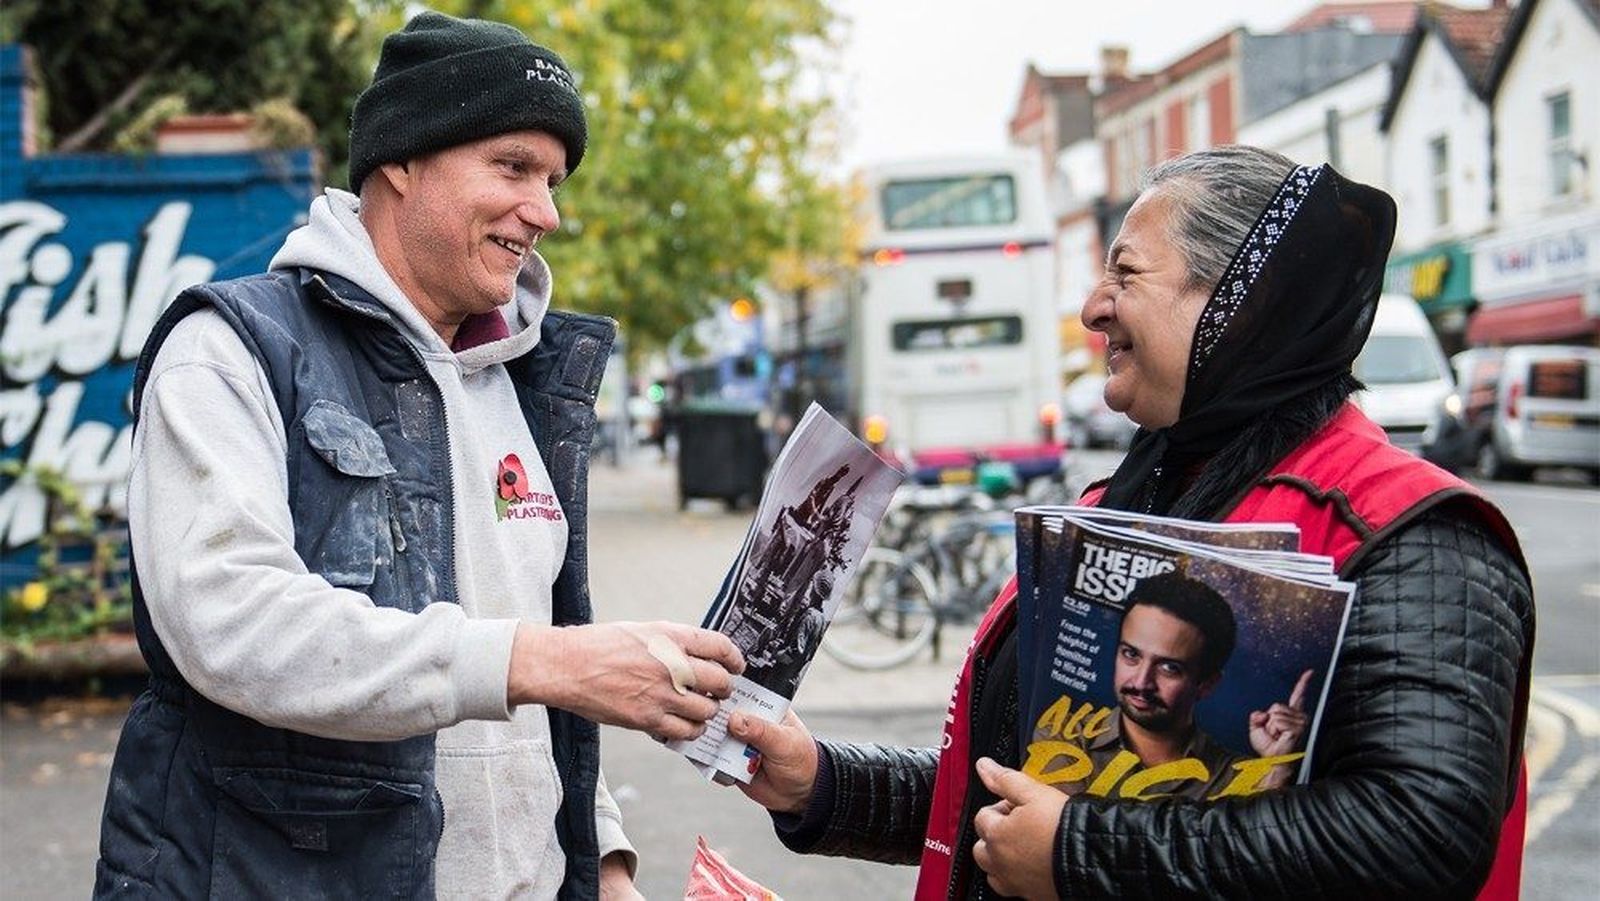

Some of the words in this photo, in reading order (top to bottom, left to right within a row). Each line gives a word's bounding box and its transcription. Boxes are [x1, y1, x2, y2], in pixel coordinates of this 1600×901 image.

[1083, 542, 1131, 575] THE
[1057, 632, 1089, 650] heights
[1088, 645, 1100, 655] of
[1056, 644, 1092, 667] Hamilton
[1050, 669, 1088, 691] Materials
[1076, 667, 1097, 682] Dark
[1037, 695, 1110, 738] ALL
